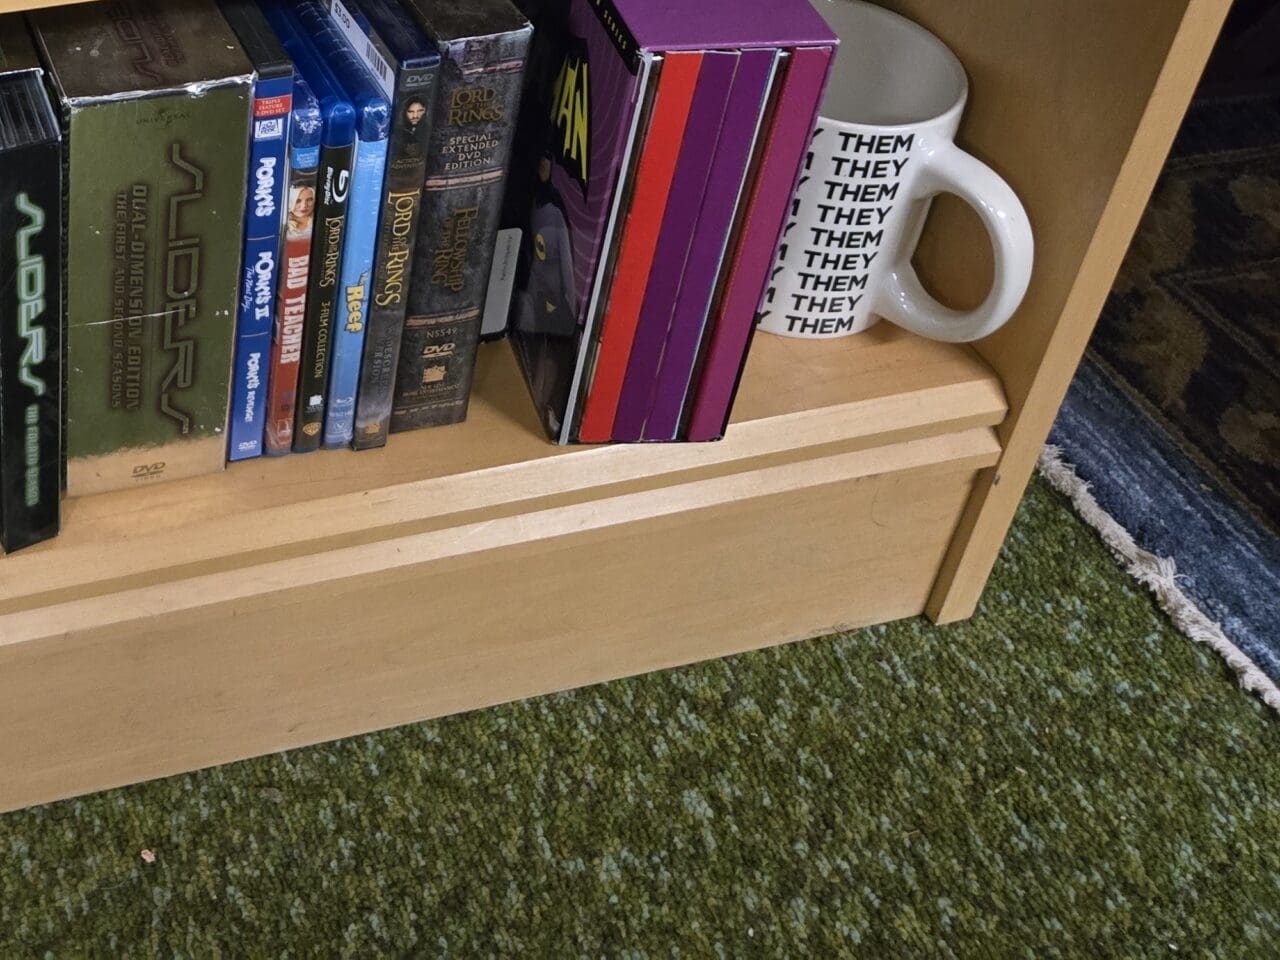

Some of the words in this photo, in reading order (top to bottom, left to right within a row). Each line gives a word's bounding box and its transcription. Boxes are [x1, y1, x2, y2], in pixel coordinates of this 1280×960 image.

[448, 86, 497, 109] LORD
[447, 104, 504, 127] RINGS
[441, 139, 500, 155] EXTENDED
[448, 133, 494, 146] SPECIAL
[837, 131, 916, 155] THEM
[444, 157, 493, 172] EDITION
[457, 150, 483, 163] DVD
[831, 156, 910, 179] THEY
[824, 180, 901, 204] THEM
[116, 192, 128, 219] THE
[388, 187, 421, 237] LORD
[817, 203, 894, 226] THEY
[115, 222, 127, 261] FIRST
[325, 214, 344, 247] LORD
[810, 226, 885, 249] THEM
[127, 182, 148, 339] DUAL-DIMENSION
[444, 205, 480, 293] FELLOWSHIP
[803, 249, 879, 271] THEY
[113, 267, 126, 295] AND
[286, 254, 311, 290] BAD
[320, 251, 340, 288] RINGS
[375, 248, 410, 306] RINGS
[797, 271, 870, 292] THEM
[344, 284, 365, 334] Reef
[791, 293, 864, 314] THEY
[112, 298, 125, 348] SECOND
[280, 292, 307, 365] TEACHER
[784, 314, 855, 335] THEM
[314, 328, 329, 379] COLLECTION
[422, 342, 457, 355] DVD
[110, 351, 124, 409] SEASONS
[126, 345, 141, 410] EDITION
[131, 461, 167, 475] DVD
